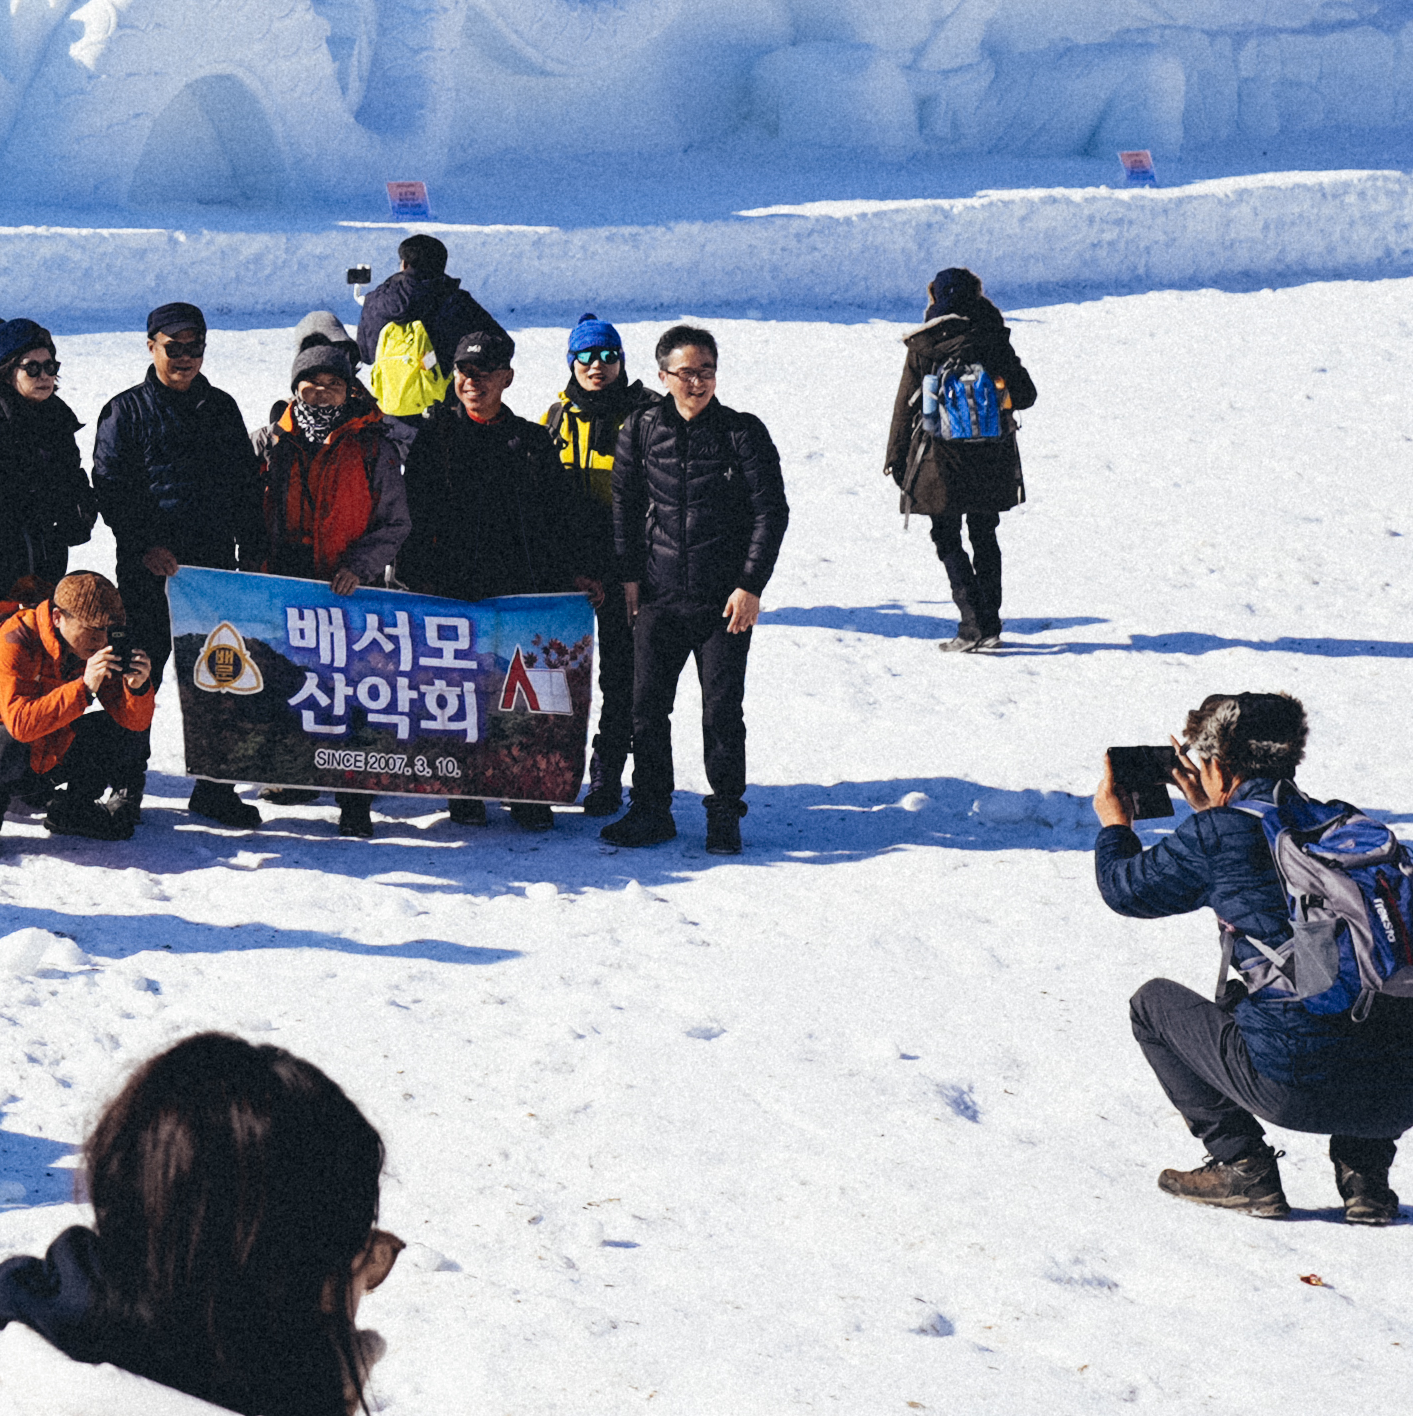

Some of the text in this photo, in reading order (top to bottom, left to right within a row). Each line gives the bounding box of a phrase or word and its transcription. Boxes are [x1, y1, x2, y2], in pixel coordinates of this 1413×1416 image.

[285, 606, 478, 671] 배서모
[287, 671, 479, 743] 산악회
[315, 749, 462, 778] SINCE 2007. 3. 10.
